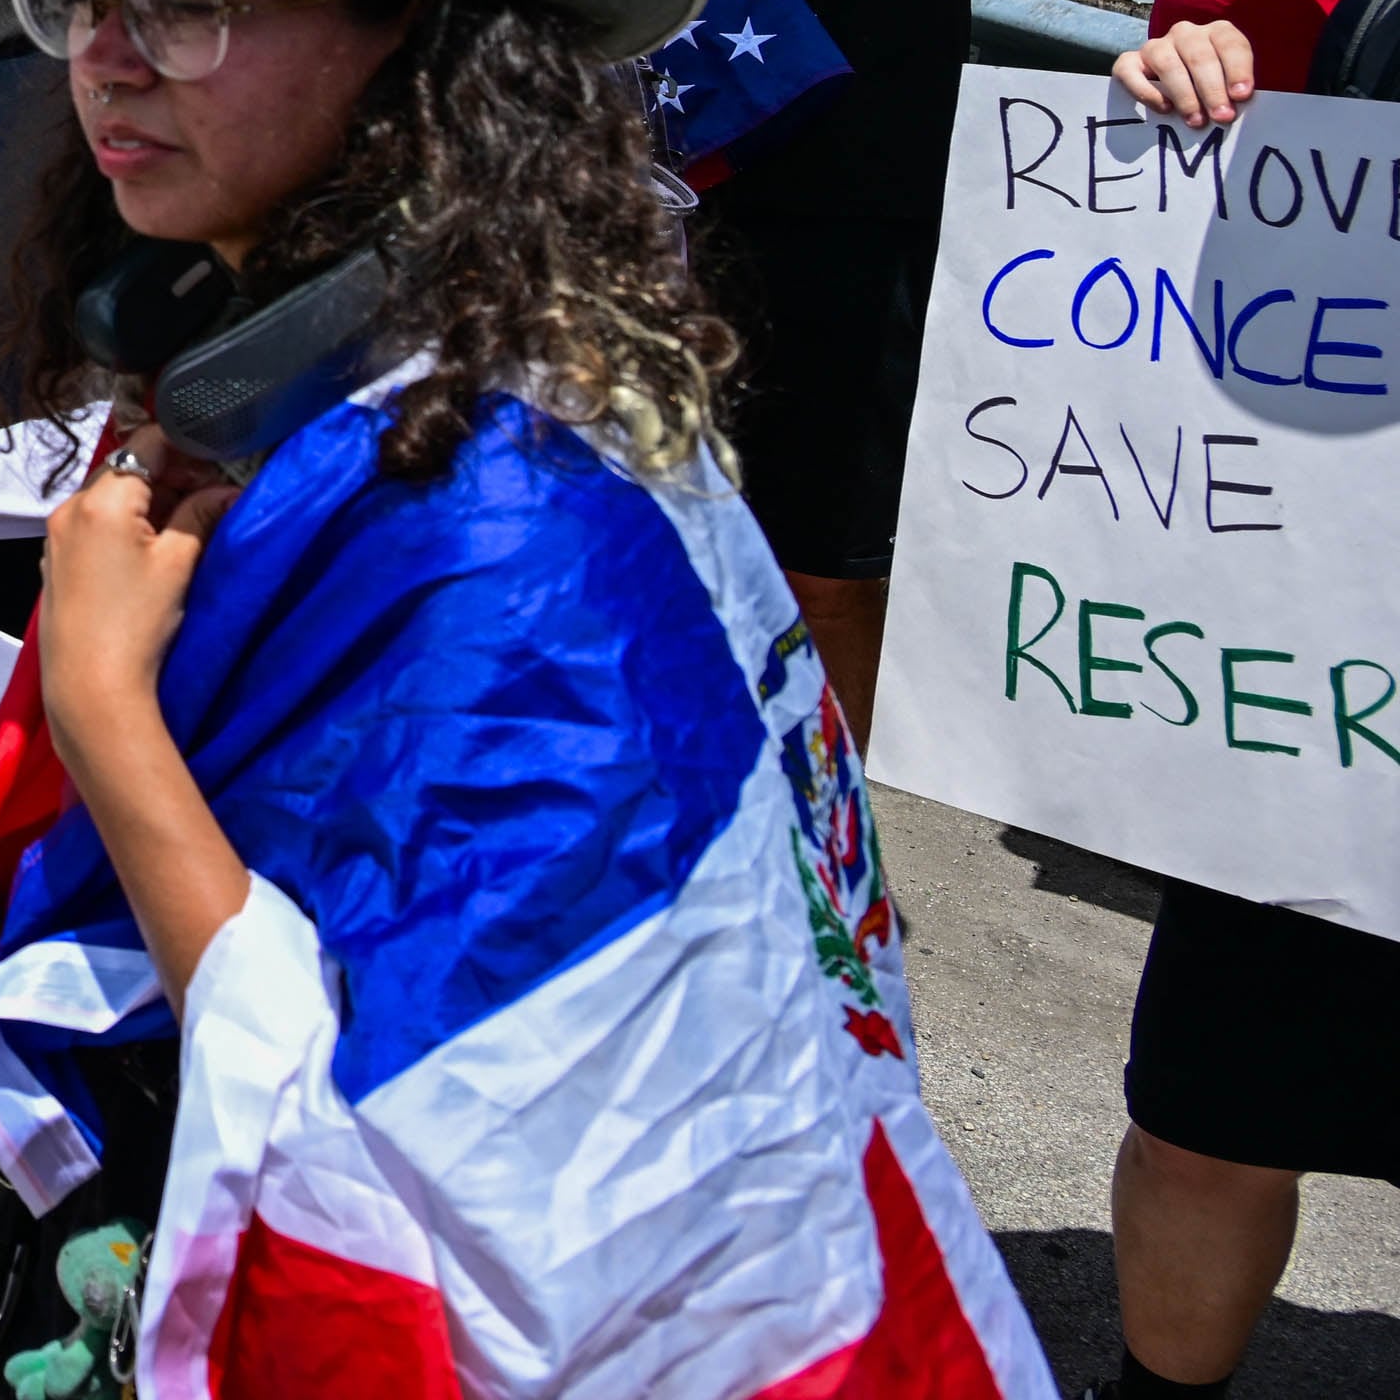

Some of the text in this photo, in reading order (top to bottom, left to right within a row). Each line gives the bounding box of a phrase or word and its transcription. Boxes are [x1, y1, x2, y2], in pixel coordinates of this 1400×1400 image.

[999, 96, 1400, 242] REMOV
[982, 248, 1389, 395] CONCE
[961, 396, 1283, 535] SAVE
